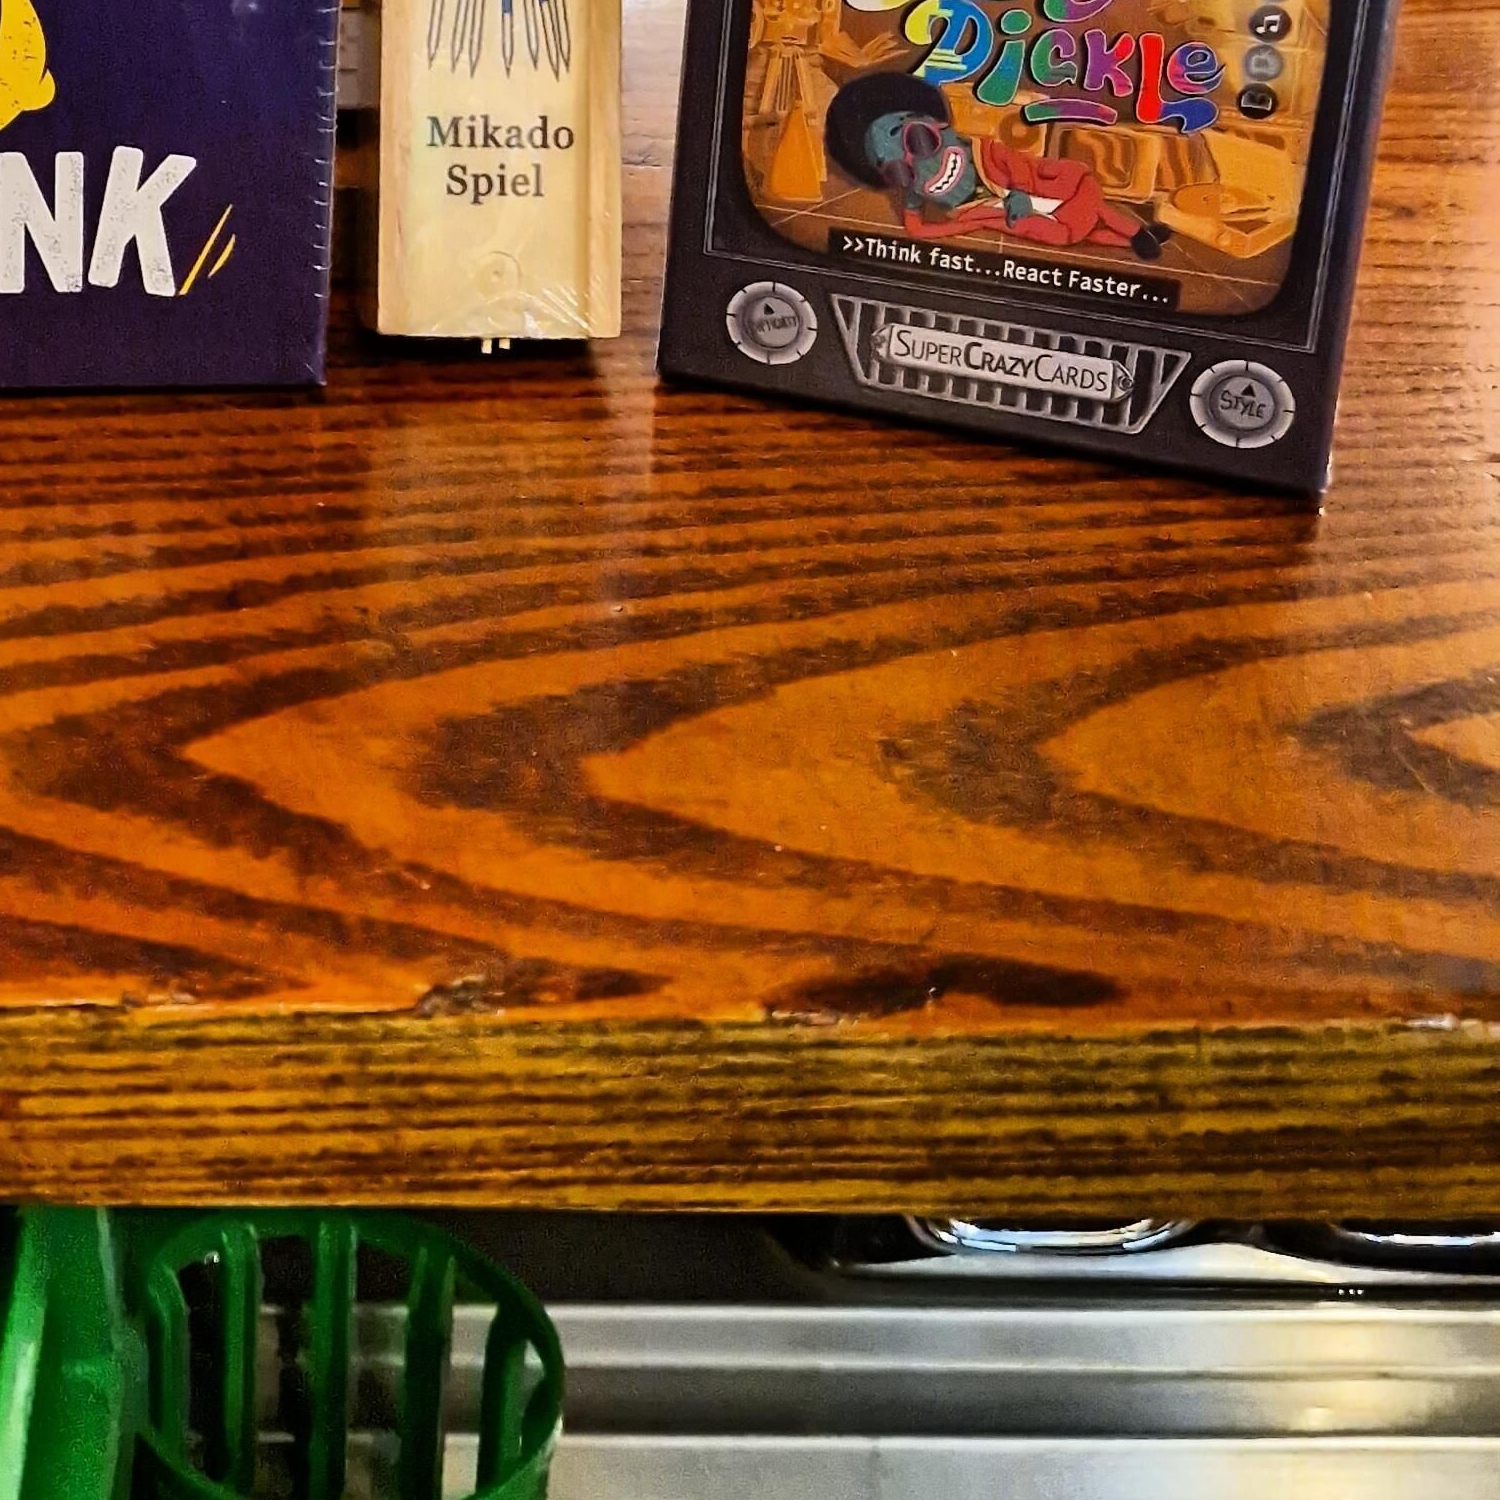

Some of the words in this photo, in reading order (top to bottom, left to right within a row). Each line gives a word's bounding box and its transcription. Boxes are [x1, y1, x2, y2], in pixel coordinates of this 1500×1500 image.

[426, 114, 575, 150] Mikado
[445, 163, 545, 205] Spiel
[1068, 270, 1170, 304] Faster...
